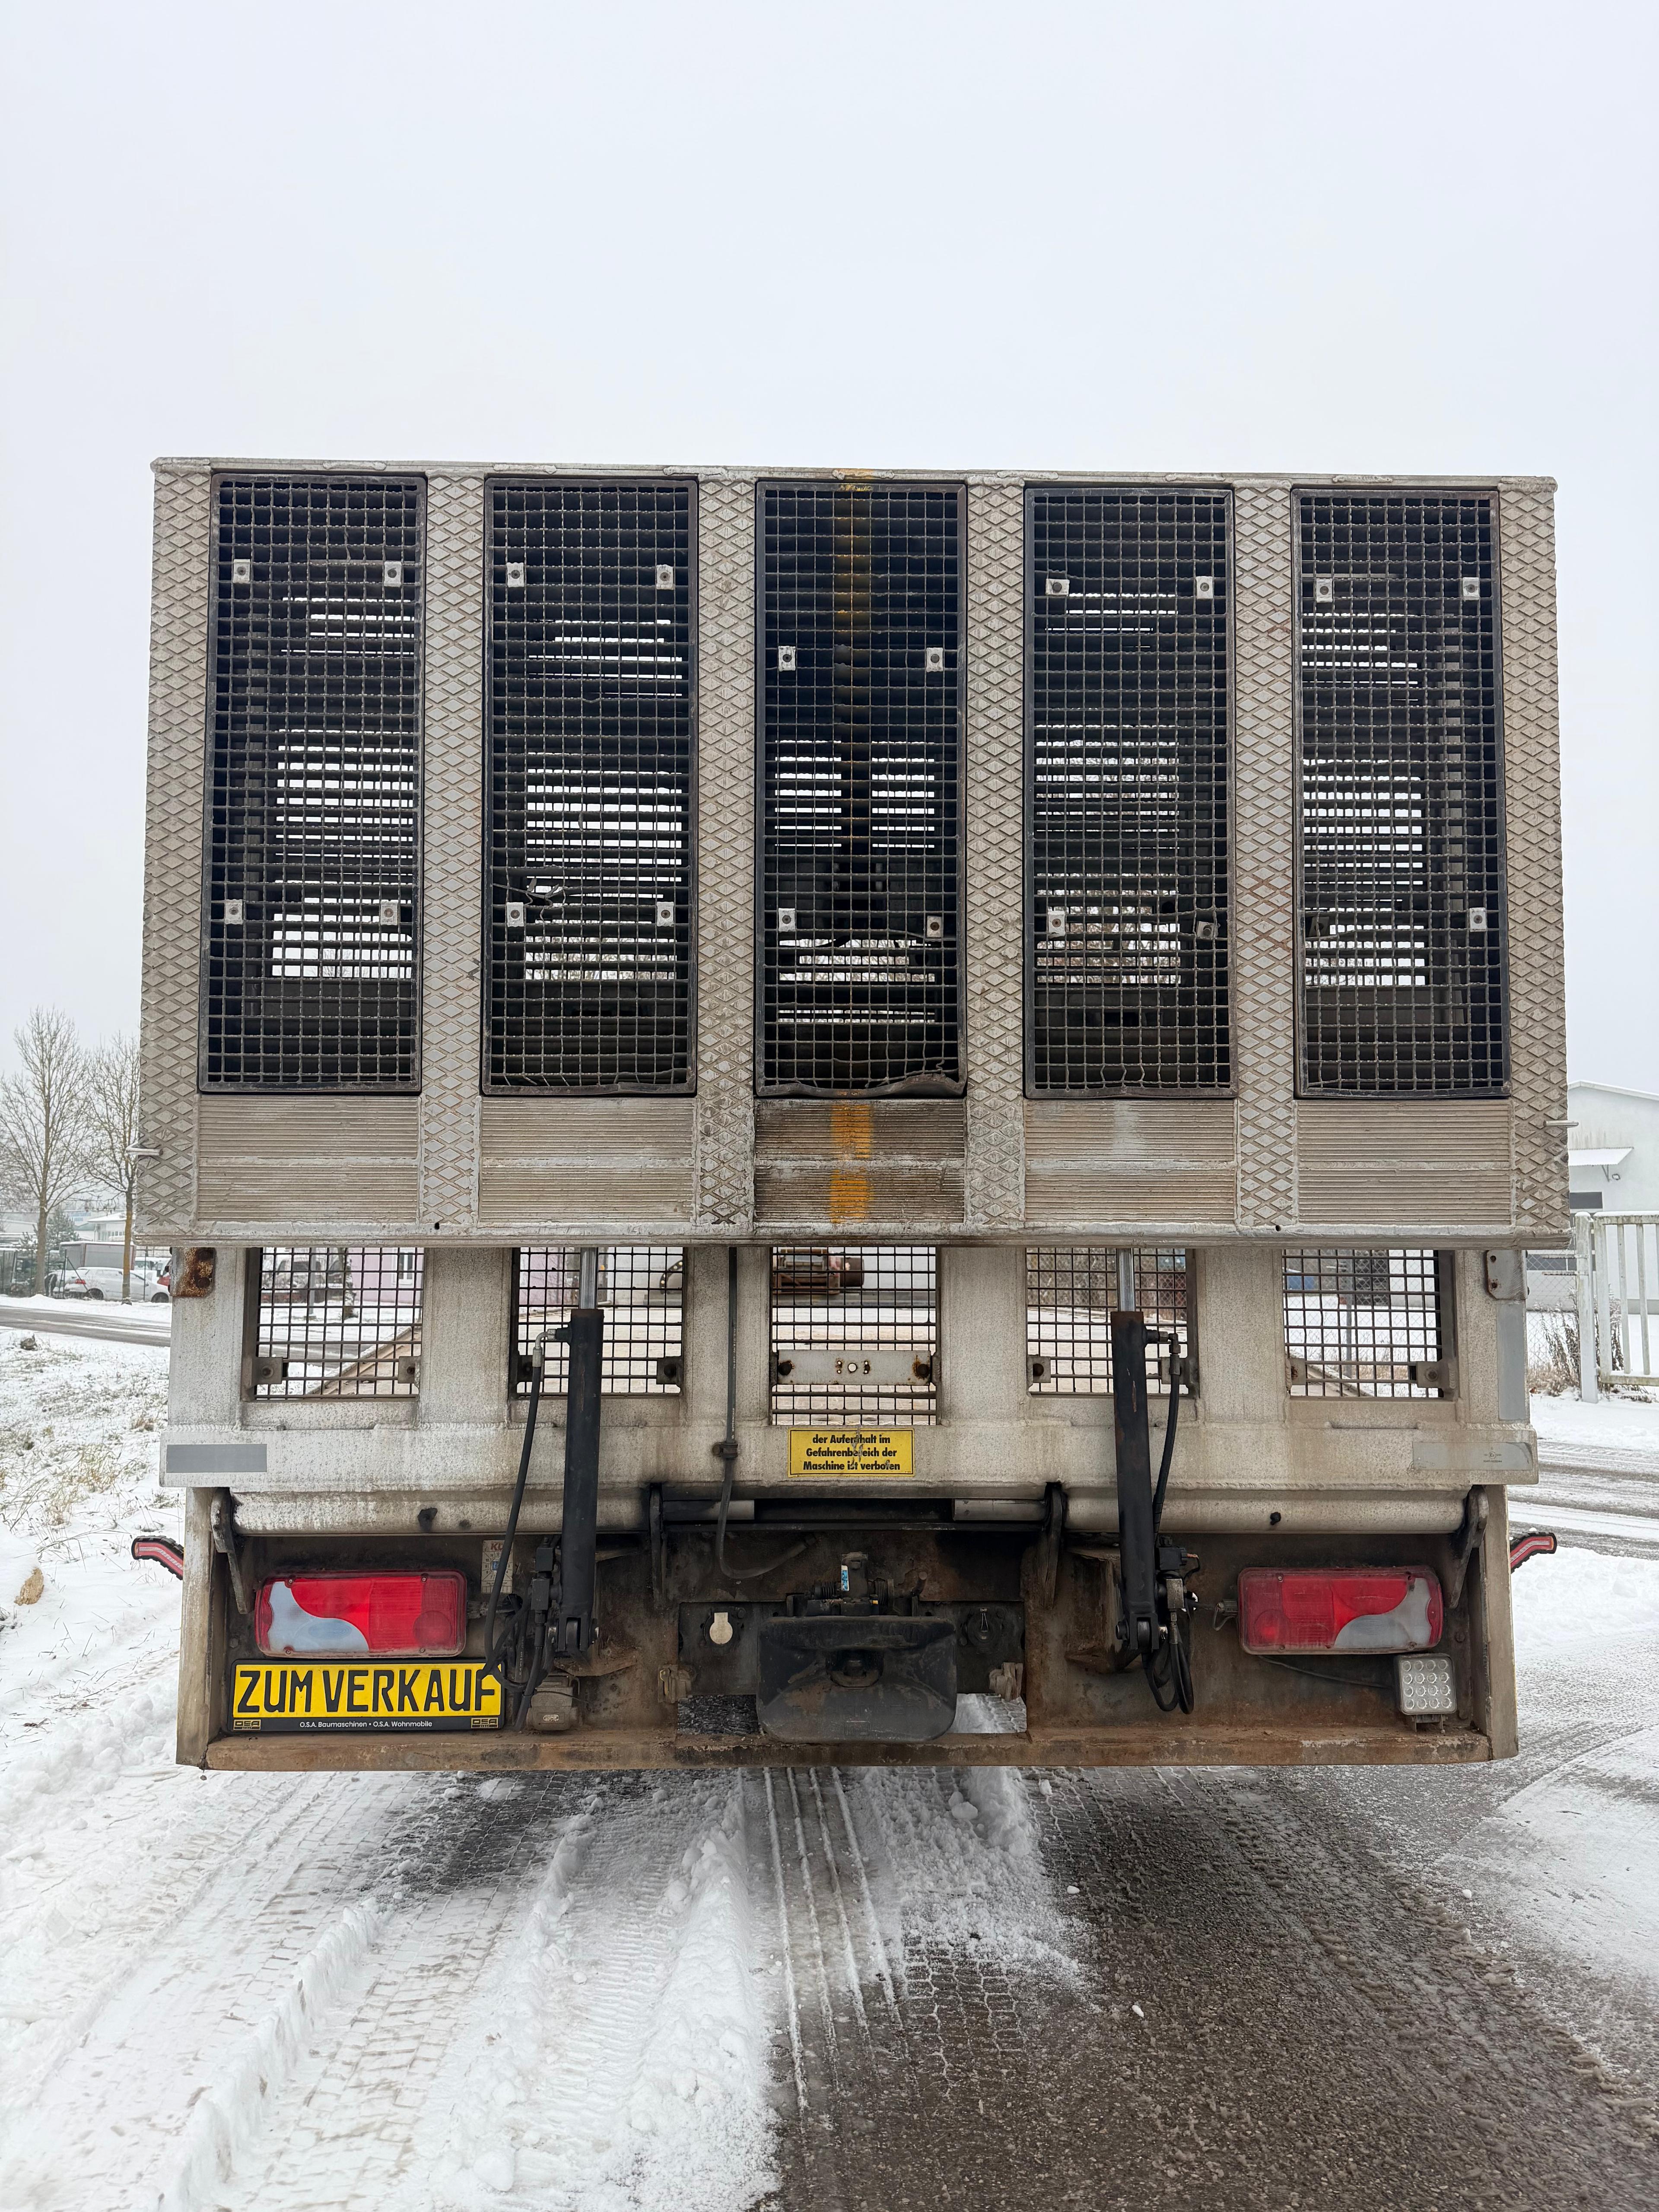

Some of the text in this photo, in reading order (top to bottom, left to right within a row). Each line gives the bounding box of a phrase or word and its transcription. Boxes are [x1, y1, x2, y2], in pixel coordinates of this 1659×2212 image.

[813, 1434, 828, 1443] der
[879, 1434, 890, 1443] im
[806, 1447, 897, 1456] Gefahrenbeeich der
[803, 1460, 845, 1470] Maschine
[847, 1461, 858, 1470] ist
[237, 1669, 495, 1713] ZUM VERKAUF
